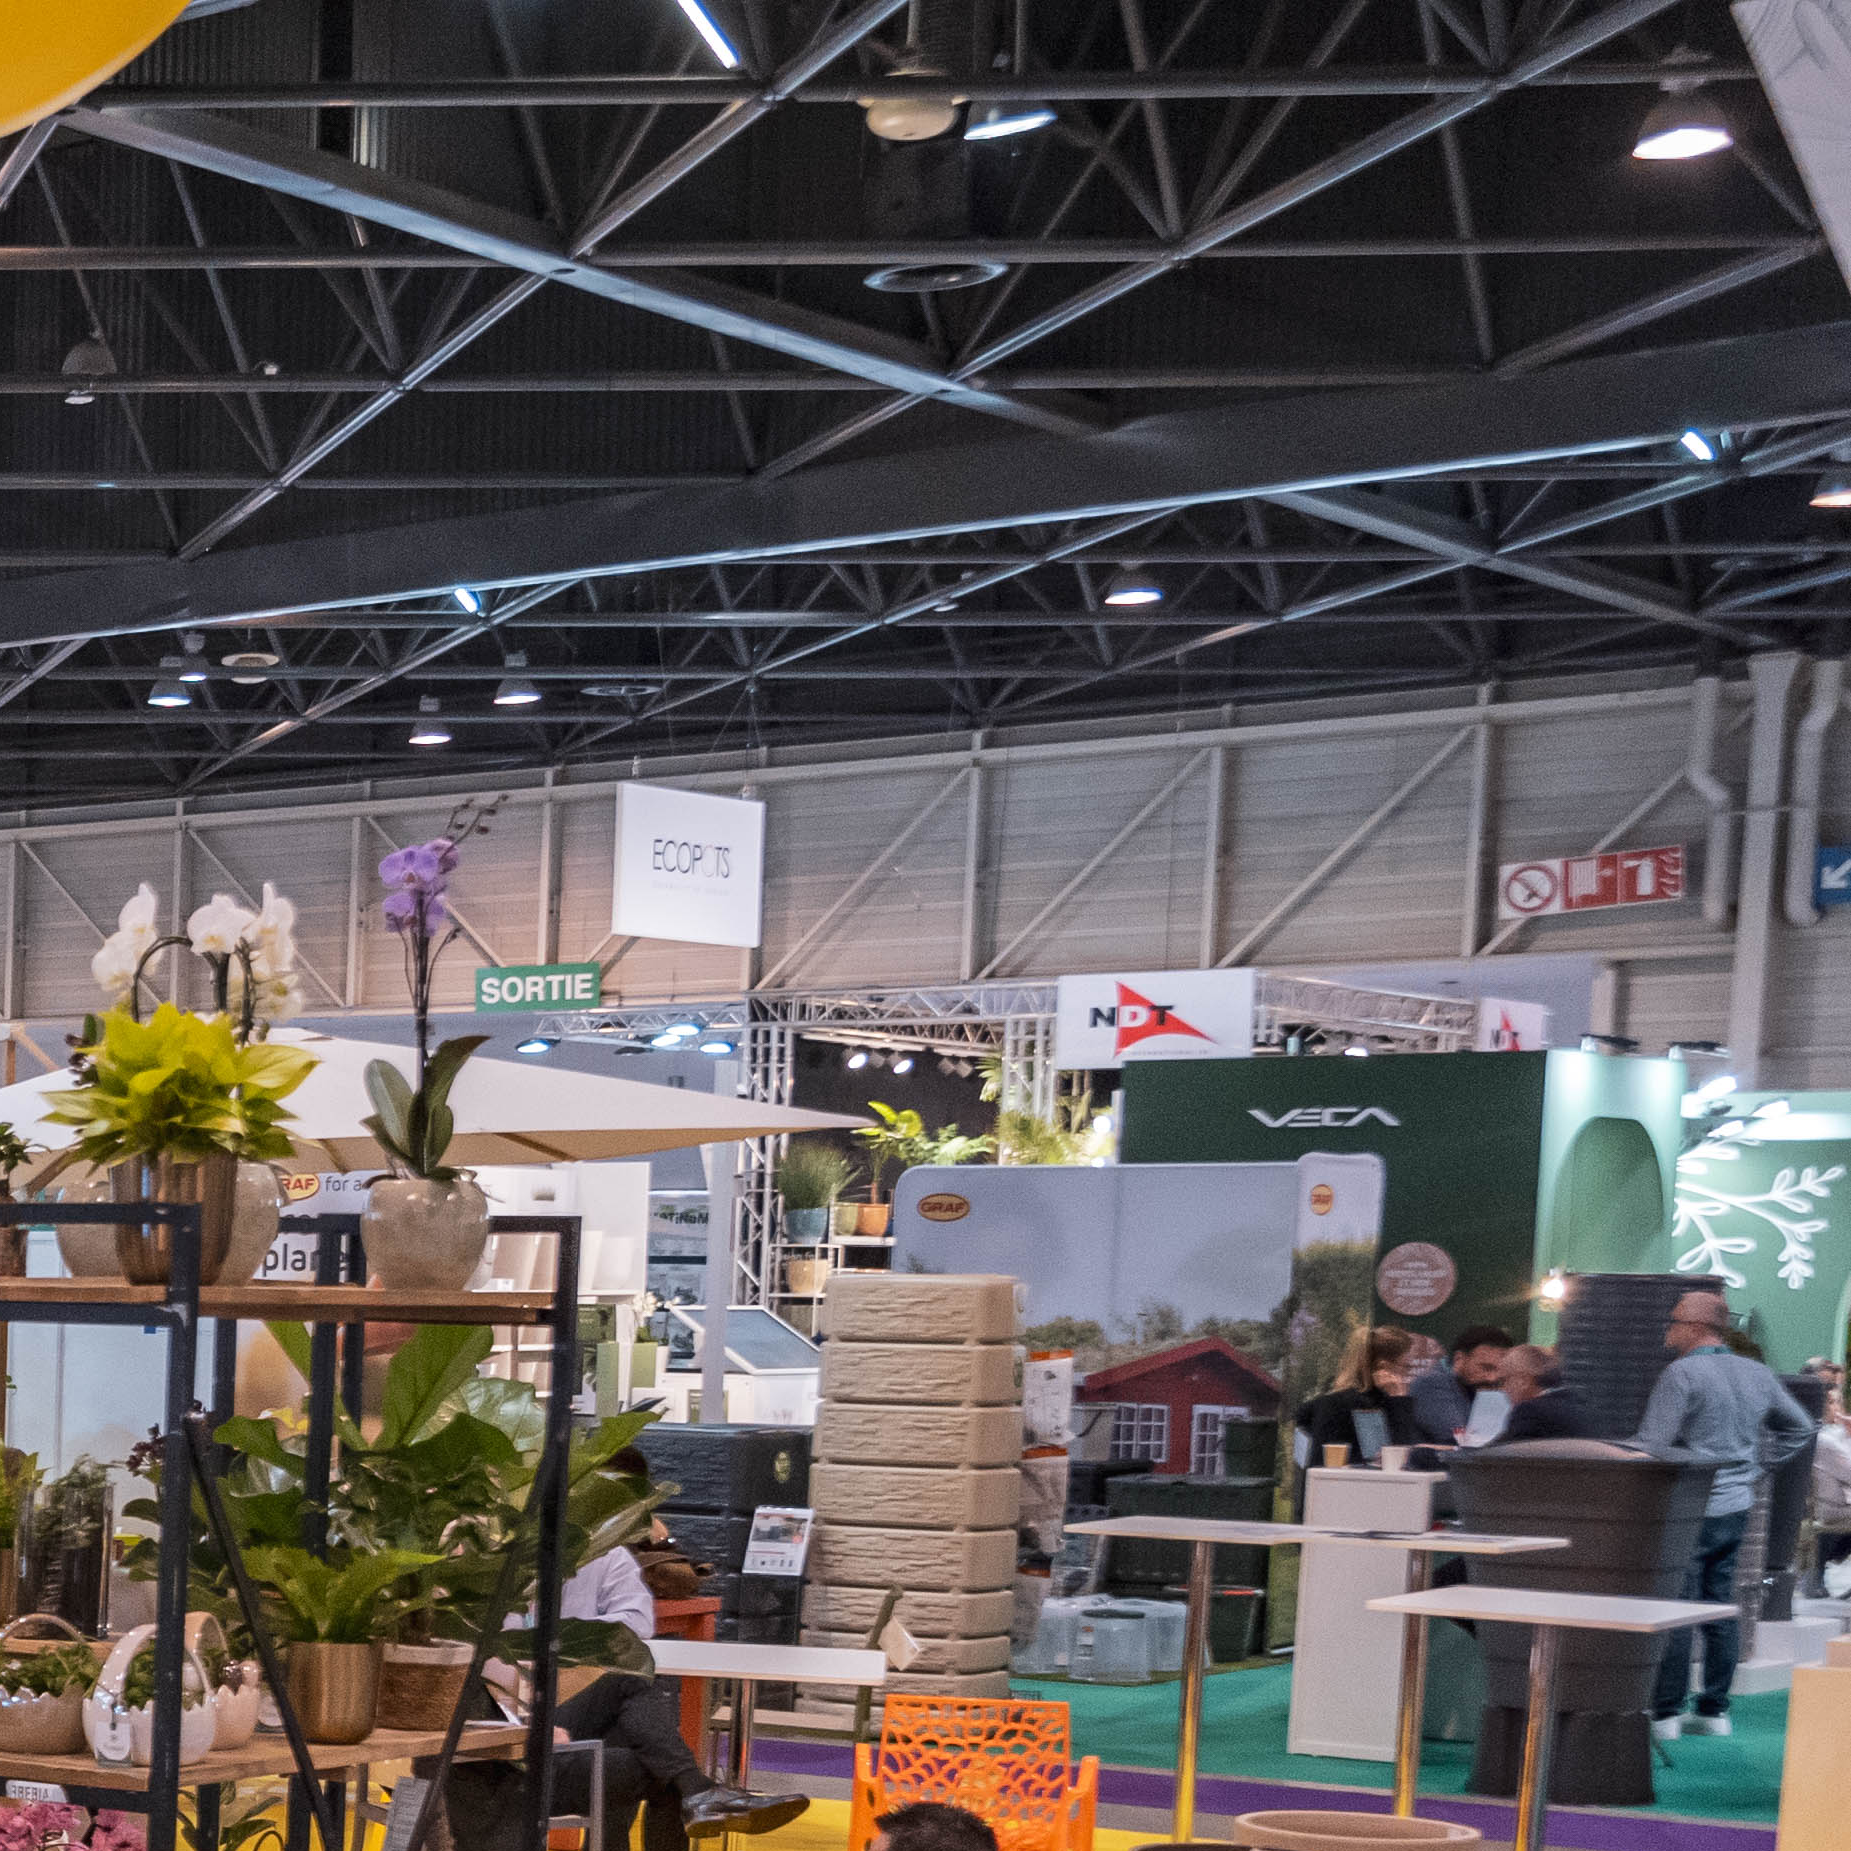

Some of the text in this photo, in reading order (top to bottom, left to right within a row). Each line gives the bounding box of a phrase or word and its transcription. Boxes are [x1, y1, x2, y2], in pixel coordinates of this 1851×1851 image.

[652, 838, 731, 879] ECOPOTS
[481, 972, 595, 1006] SORTIE
[1089, 1005, 1176, 1029] NDT
[1247, 1107, 1402, 1128] VECA
[325, 1176, 348, 1192] for
[920, 1202, 966, 1213] GRAF
